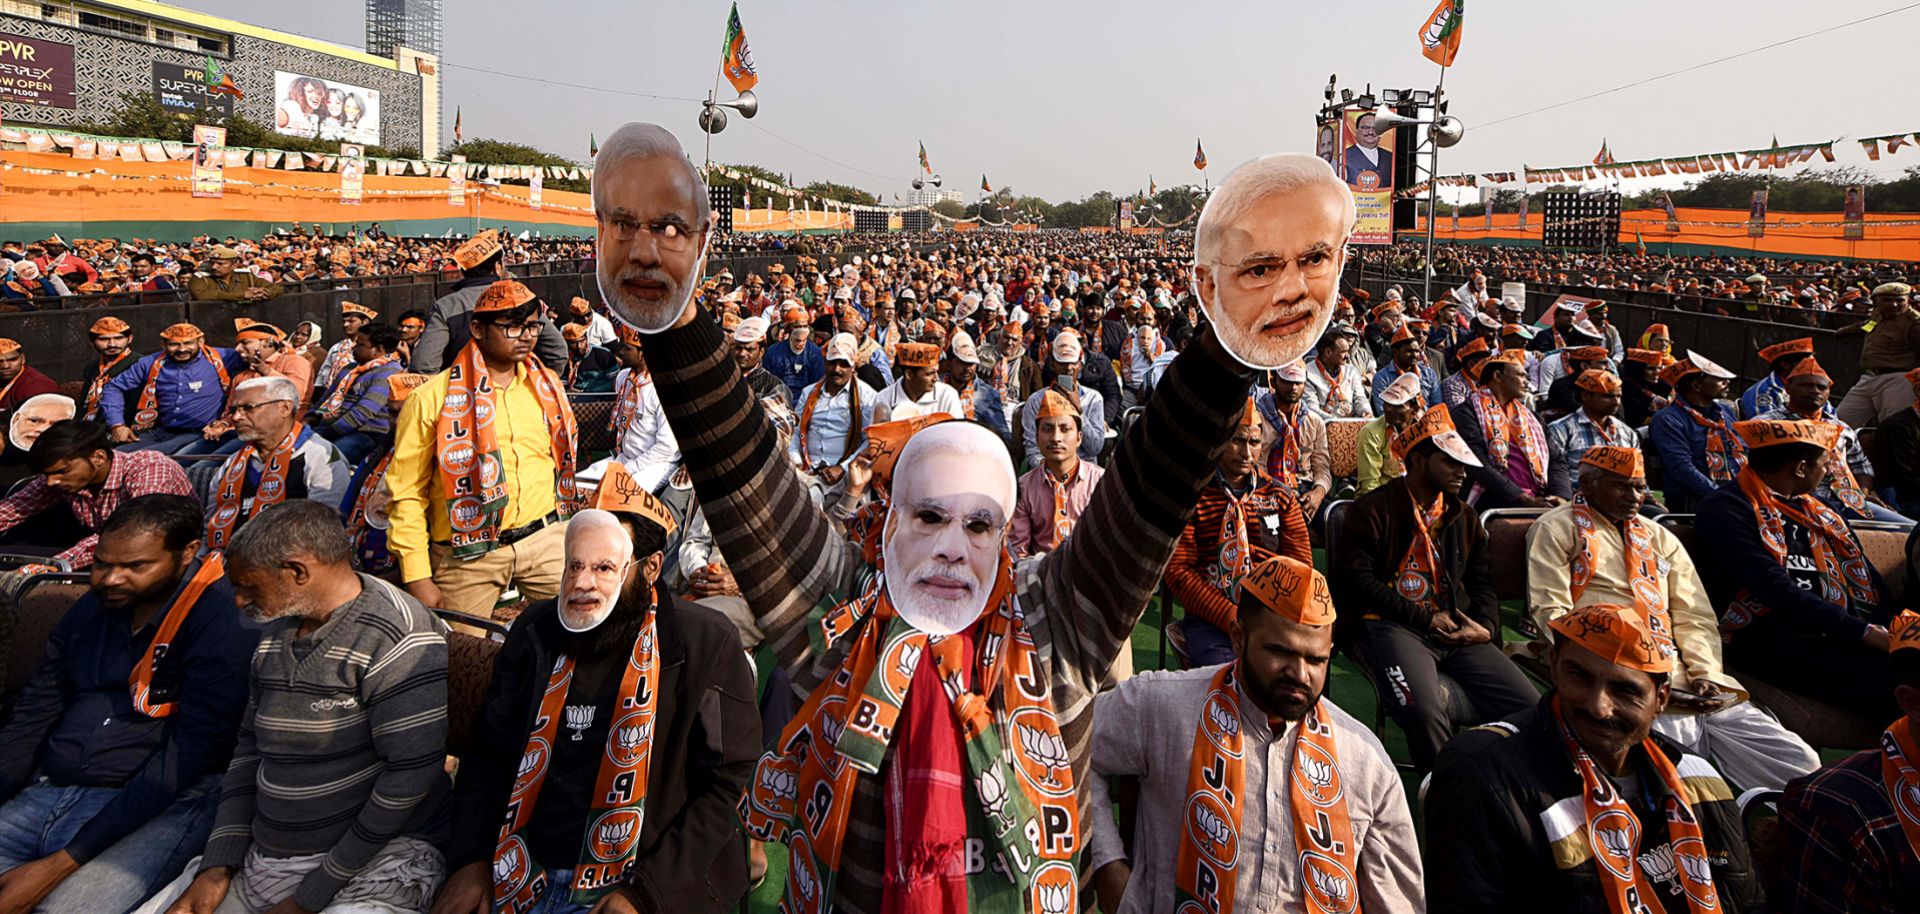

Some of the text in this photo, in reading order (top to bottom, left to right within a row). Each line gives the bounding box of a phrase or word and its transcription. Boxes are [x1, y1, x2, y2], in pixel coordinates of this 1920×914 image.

[184, 68, 204, 82] PVR
[14, 88, 39, 97] FLOOR
[17, 79, 52, 92] OPEN
[162, 98, 195, 109] IMAX
[1203, 753, 1235, 808] J.
[1040, 804, 1074, 855] P.
[1305, 810, 1344, 856] J.
